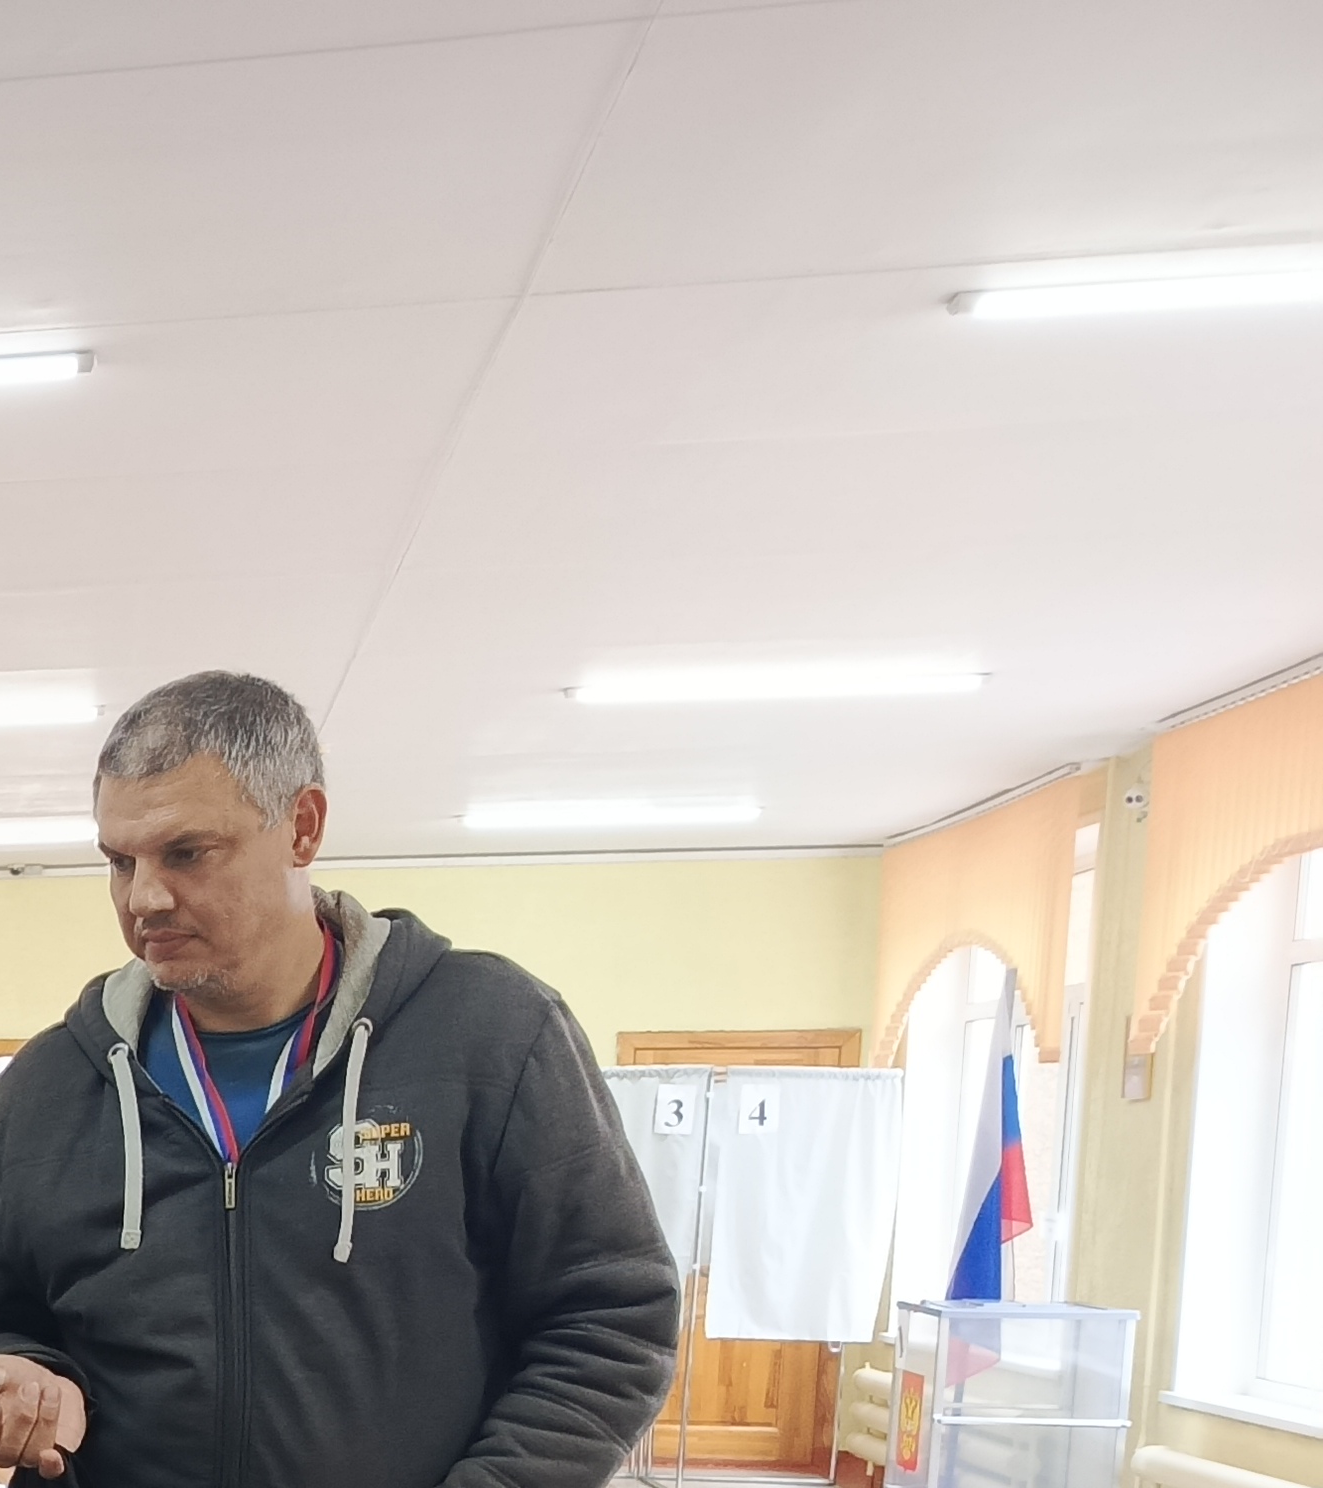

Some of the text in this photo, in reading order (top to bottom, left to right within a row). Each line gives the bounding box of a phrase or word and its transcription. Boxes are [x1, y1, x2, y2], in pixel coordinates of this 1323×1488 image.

[664, 1099, 684, 1127] 3
[748, 1099, 767, 1126] 4
[355, 1187, 394, 1202] HERO
